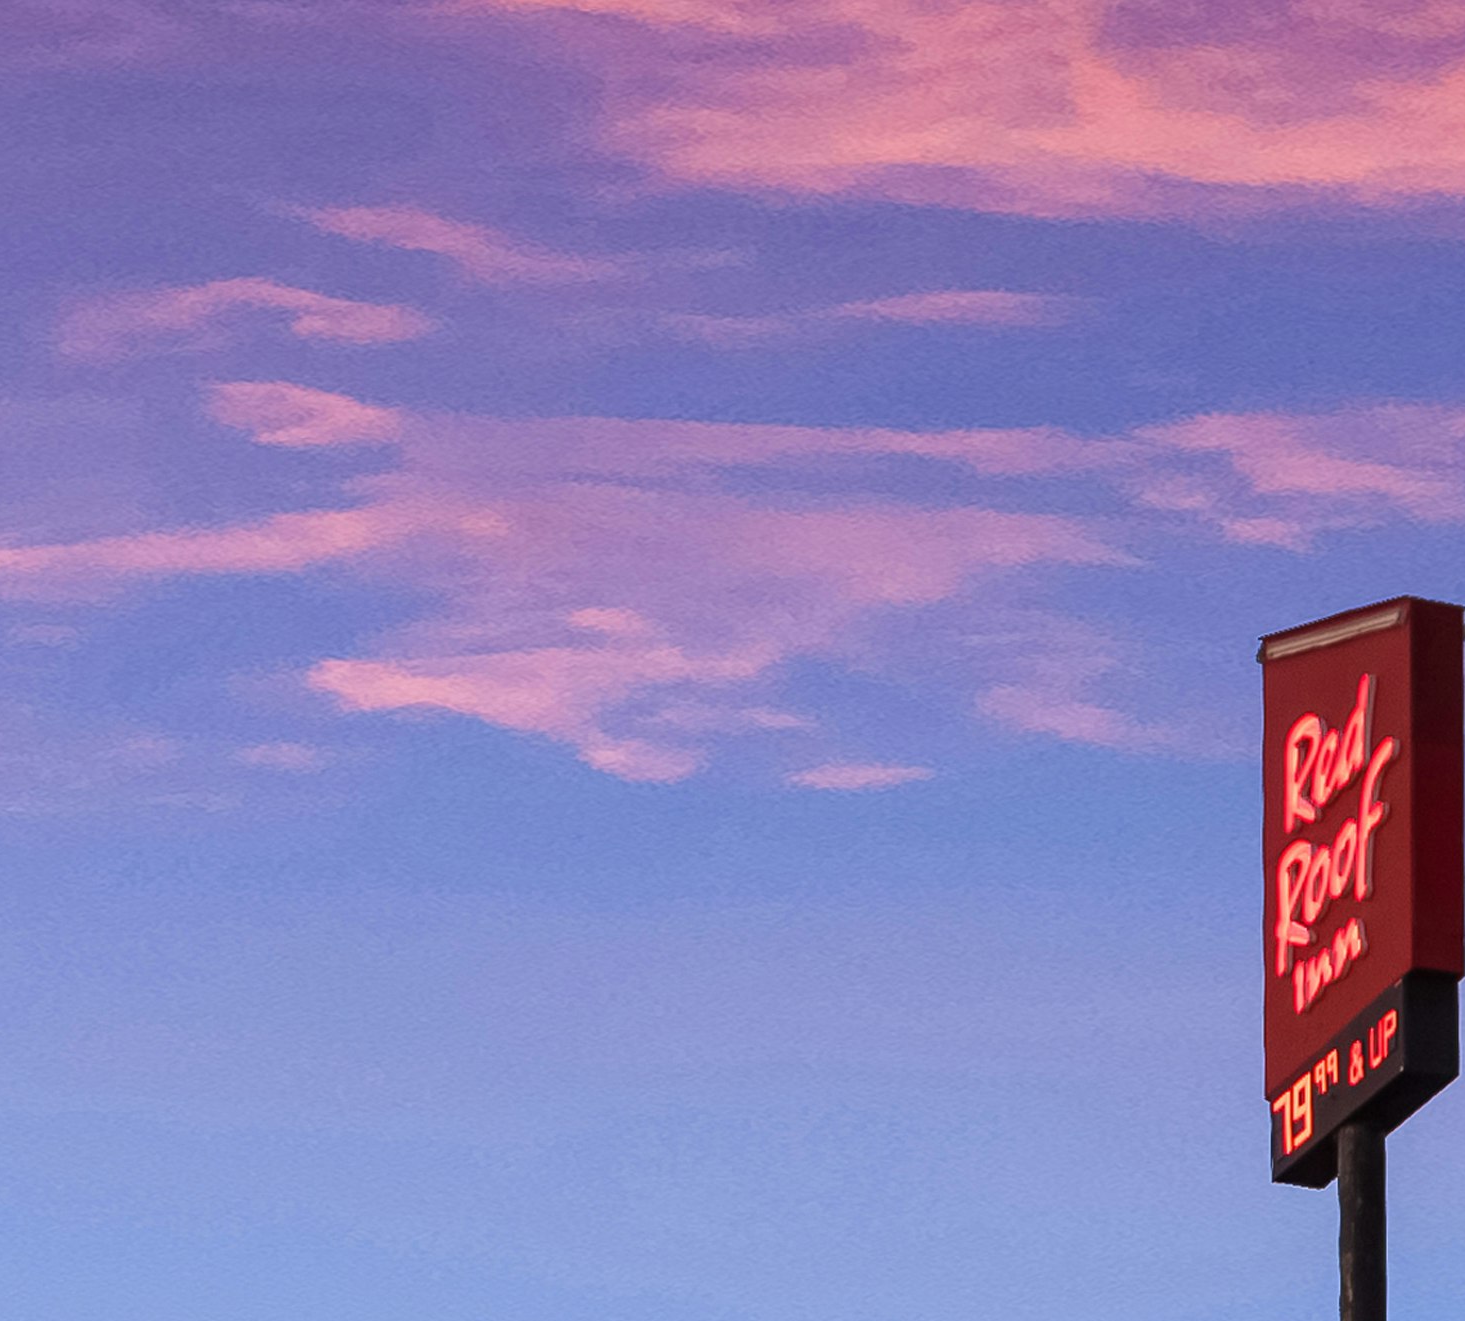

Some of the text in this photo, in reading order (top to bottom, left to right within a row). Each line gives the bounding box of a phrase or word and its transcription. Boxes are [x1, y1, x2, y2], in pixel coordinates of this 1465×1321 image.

[1284, 673, 1371, 834] Red
[1275, 735, 1396, 977] Roof
[1348, 1038, 1365, 1087] &
[1368, 1007, 1398, 1070] UP
